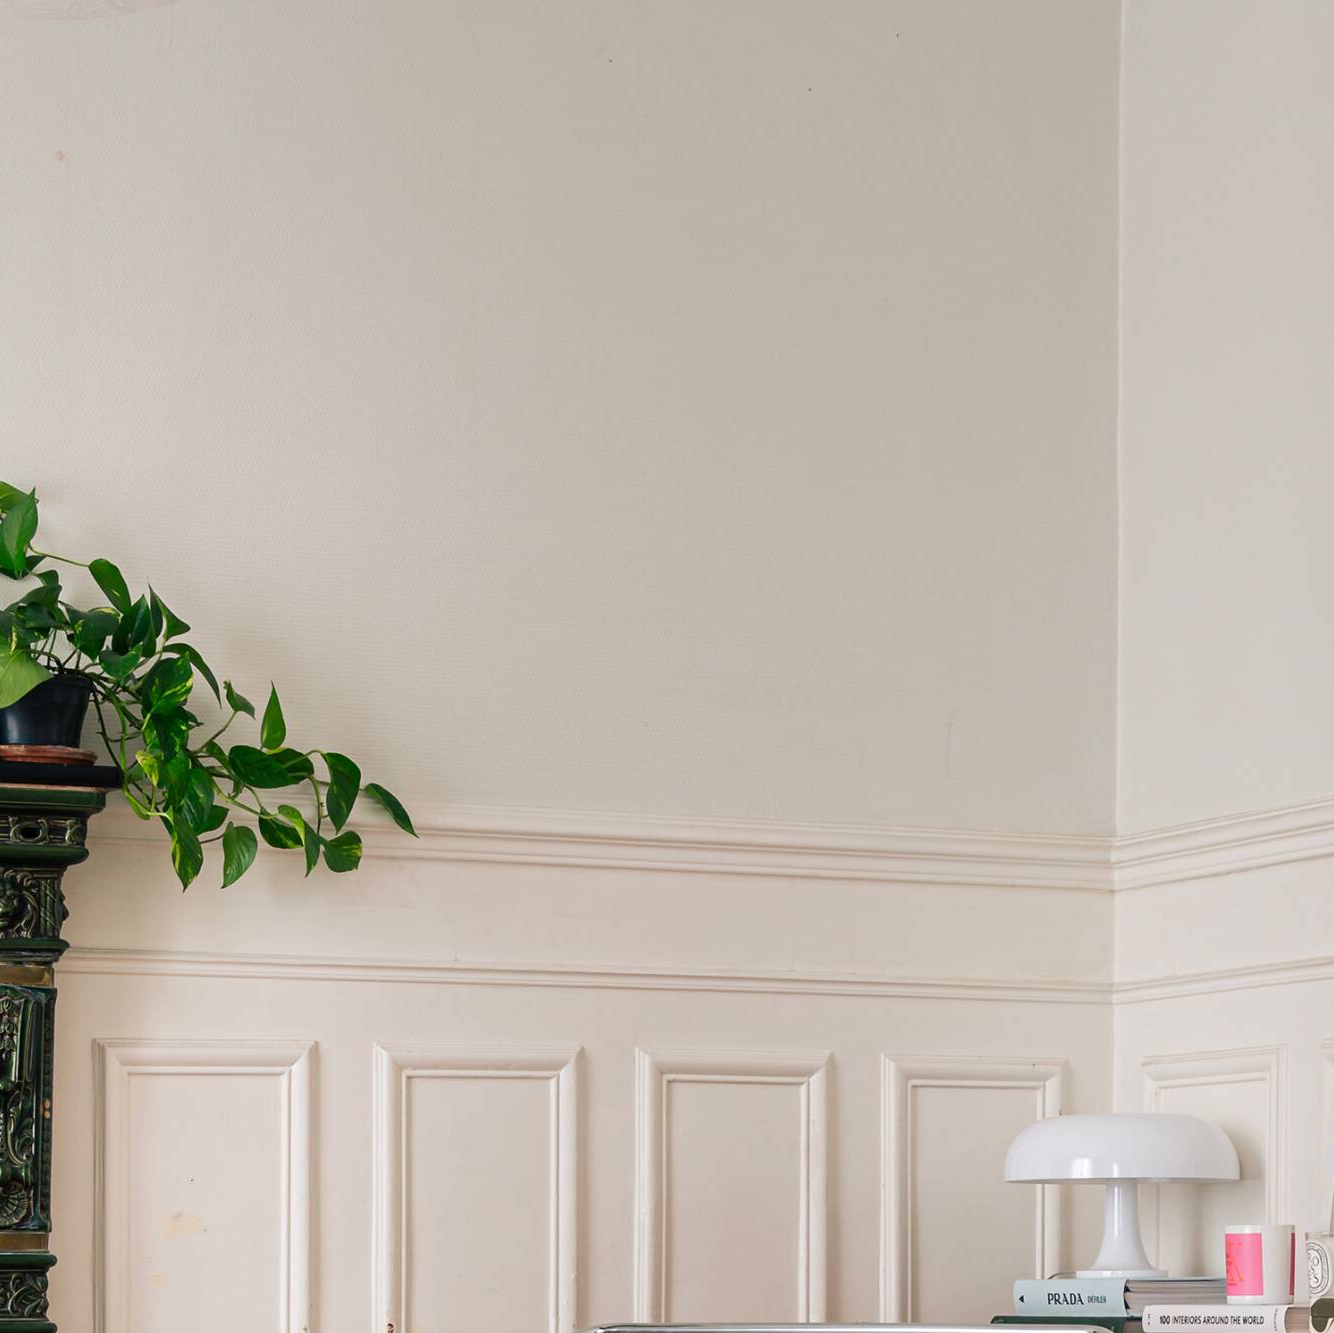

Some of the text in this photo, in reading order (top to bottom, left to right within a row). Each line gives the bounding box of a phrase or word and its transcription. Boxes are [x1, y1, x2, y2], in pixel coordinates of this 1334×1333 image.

[1047, 1293, 1084, 1305] PRADA
[1159, 1315, 1264, 1325] 100 INTERIORS AROUND THE WORLD
